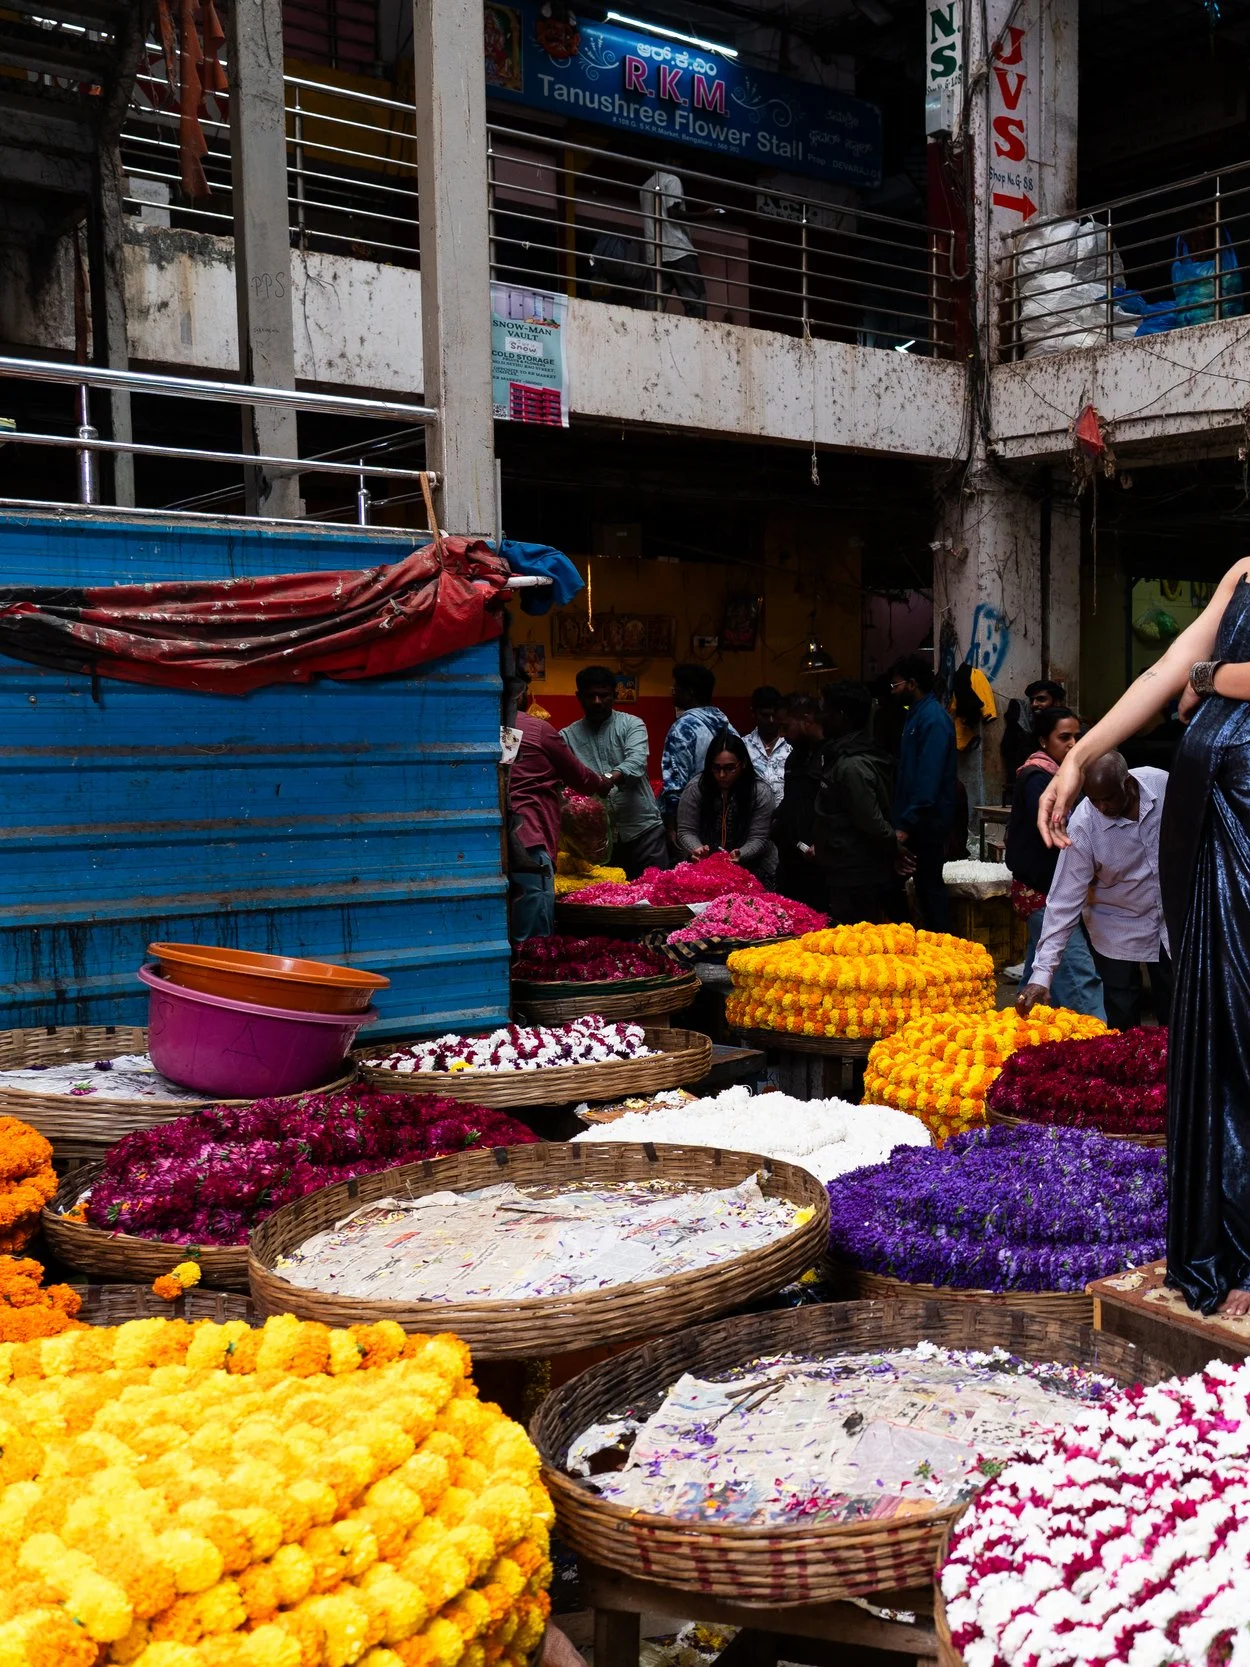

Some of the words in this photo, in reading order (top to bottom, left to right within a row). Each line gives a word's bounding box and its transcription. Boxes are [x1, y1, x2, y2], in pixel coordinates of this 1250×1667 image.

[624, 54, 731, 118] R.K.M.
[537, 73, 668, 126] Tanushree
[675, 110, 751, 147] Flower
[756, 131, 803, 161] Stall
[493, 319, 552, 336] SNOW-MAN
[507, 330, 539, 341] VAULT
[510, 342, 537, 354] Snow
[492, 350, 515, 359] COLD
[516, 354, 555, 366] STORAGE
